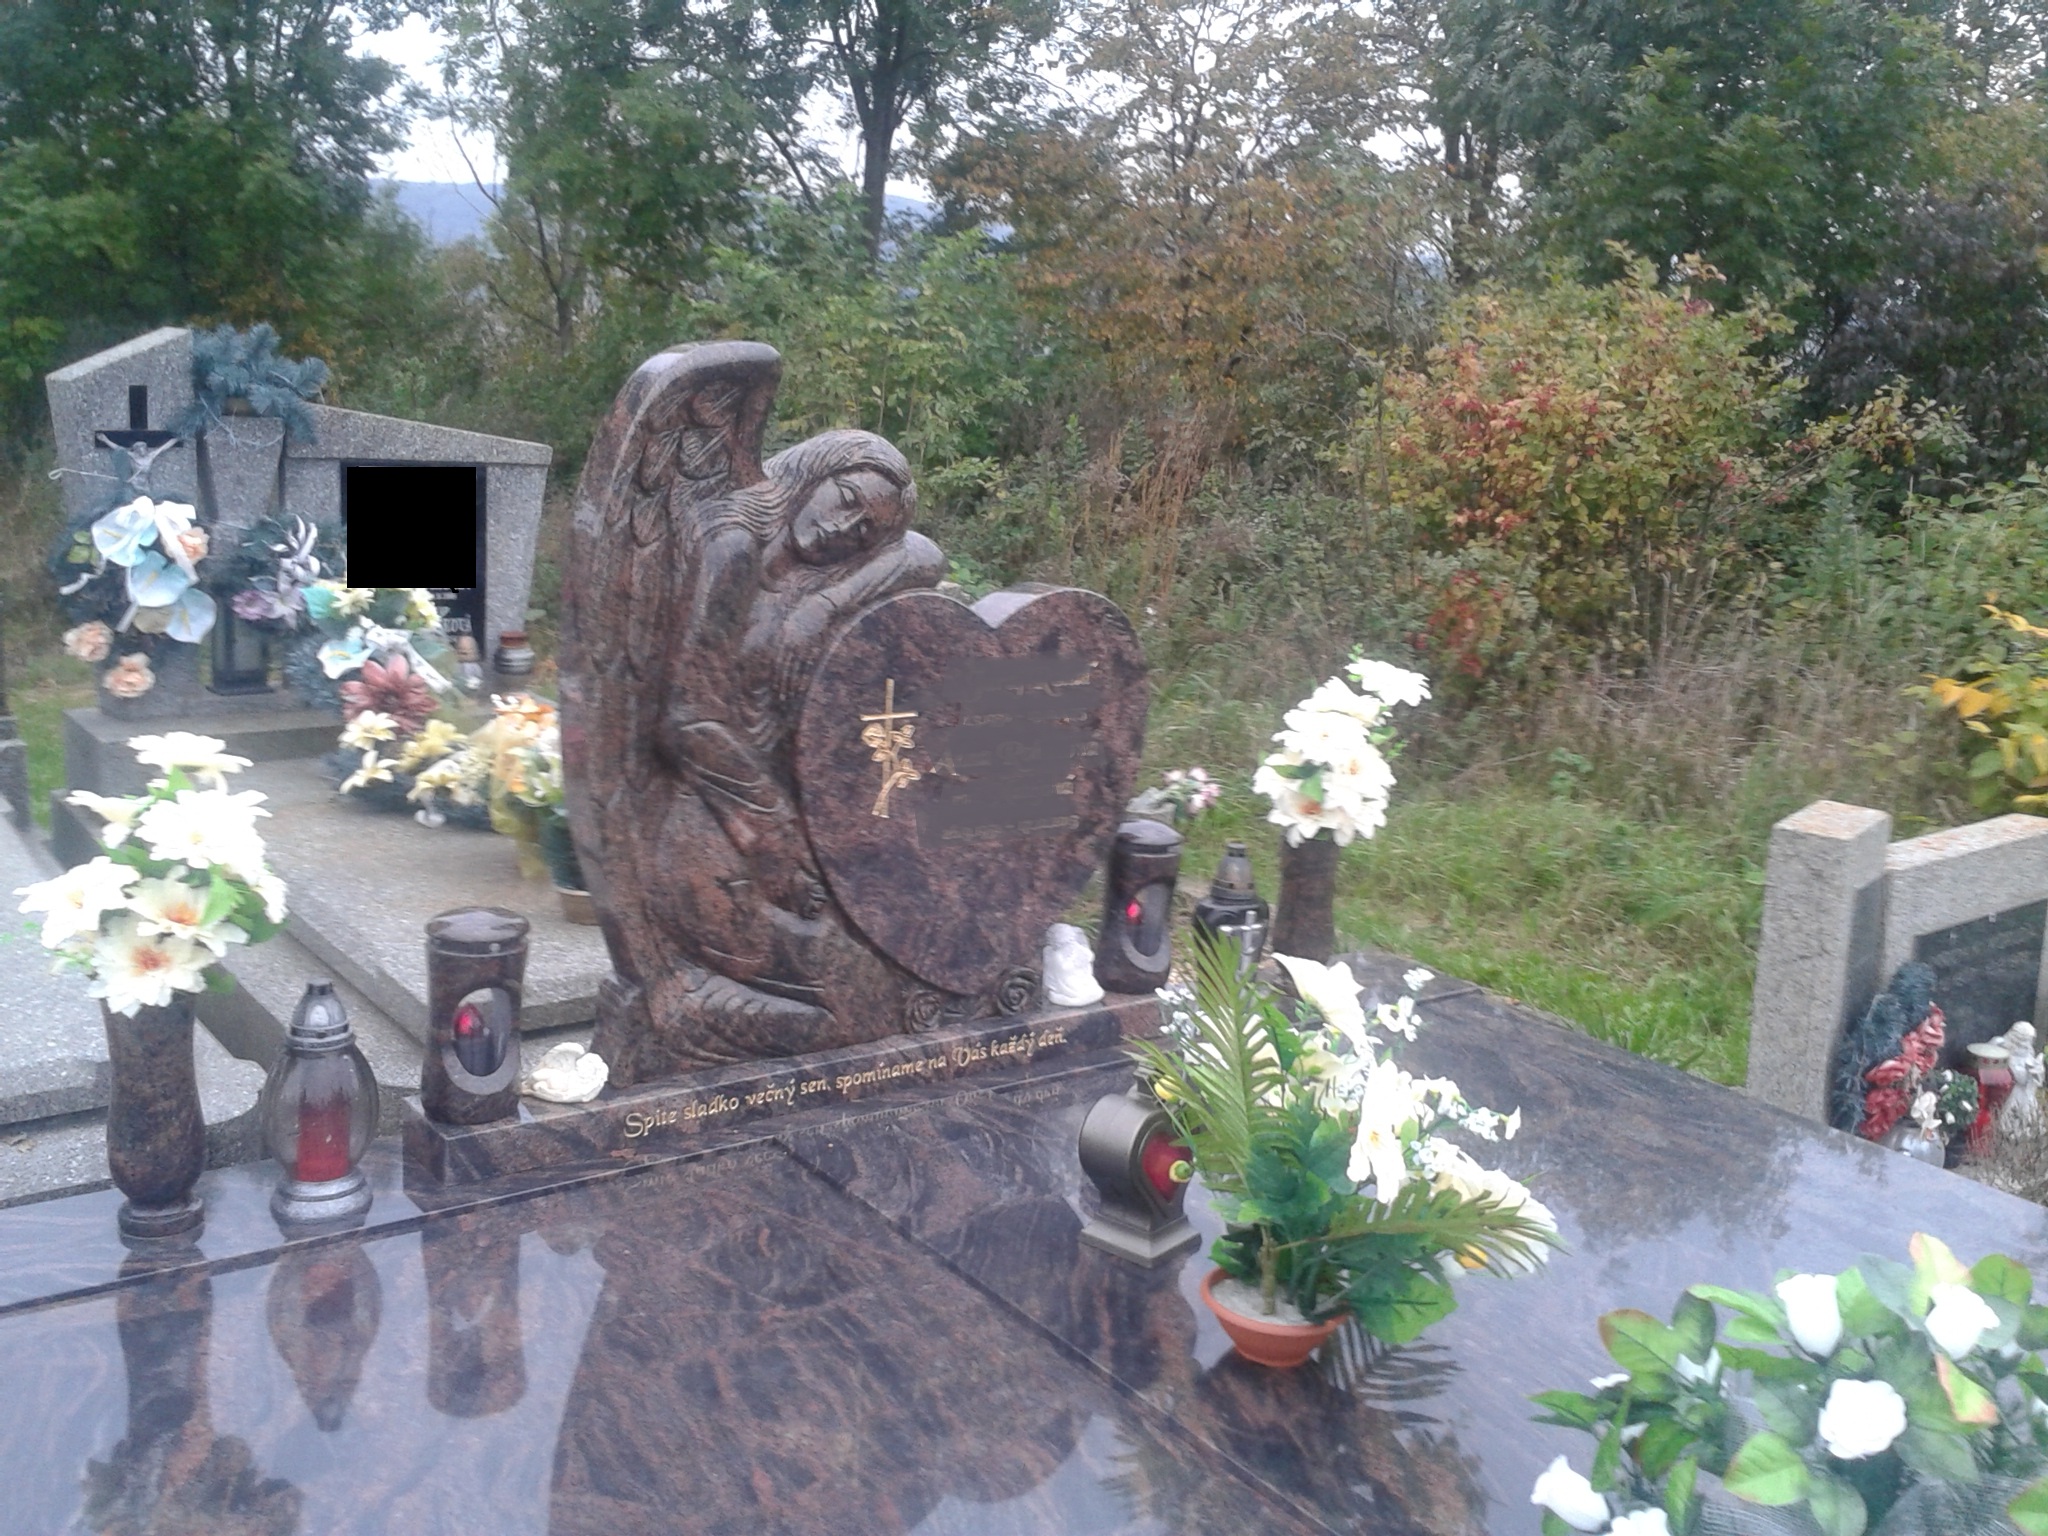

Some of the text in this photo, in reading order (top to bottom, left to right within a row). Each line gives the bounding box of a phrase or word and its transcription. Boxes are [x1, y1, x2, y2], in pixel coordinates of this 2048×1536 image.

[624, 1109, 678, 1138] Spite
[684, 1094, 739, 1120] sladko
[745, 1079, 796, 1106] večný
[928, 1054, 947, 1070] na
[991, 1032, 1036, 1057] každý
